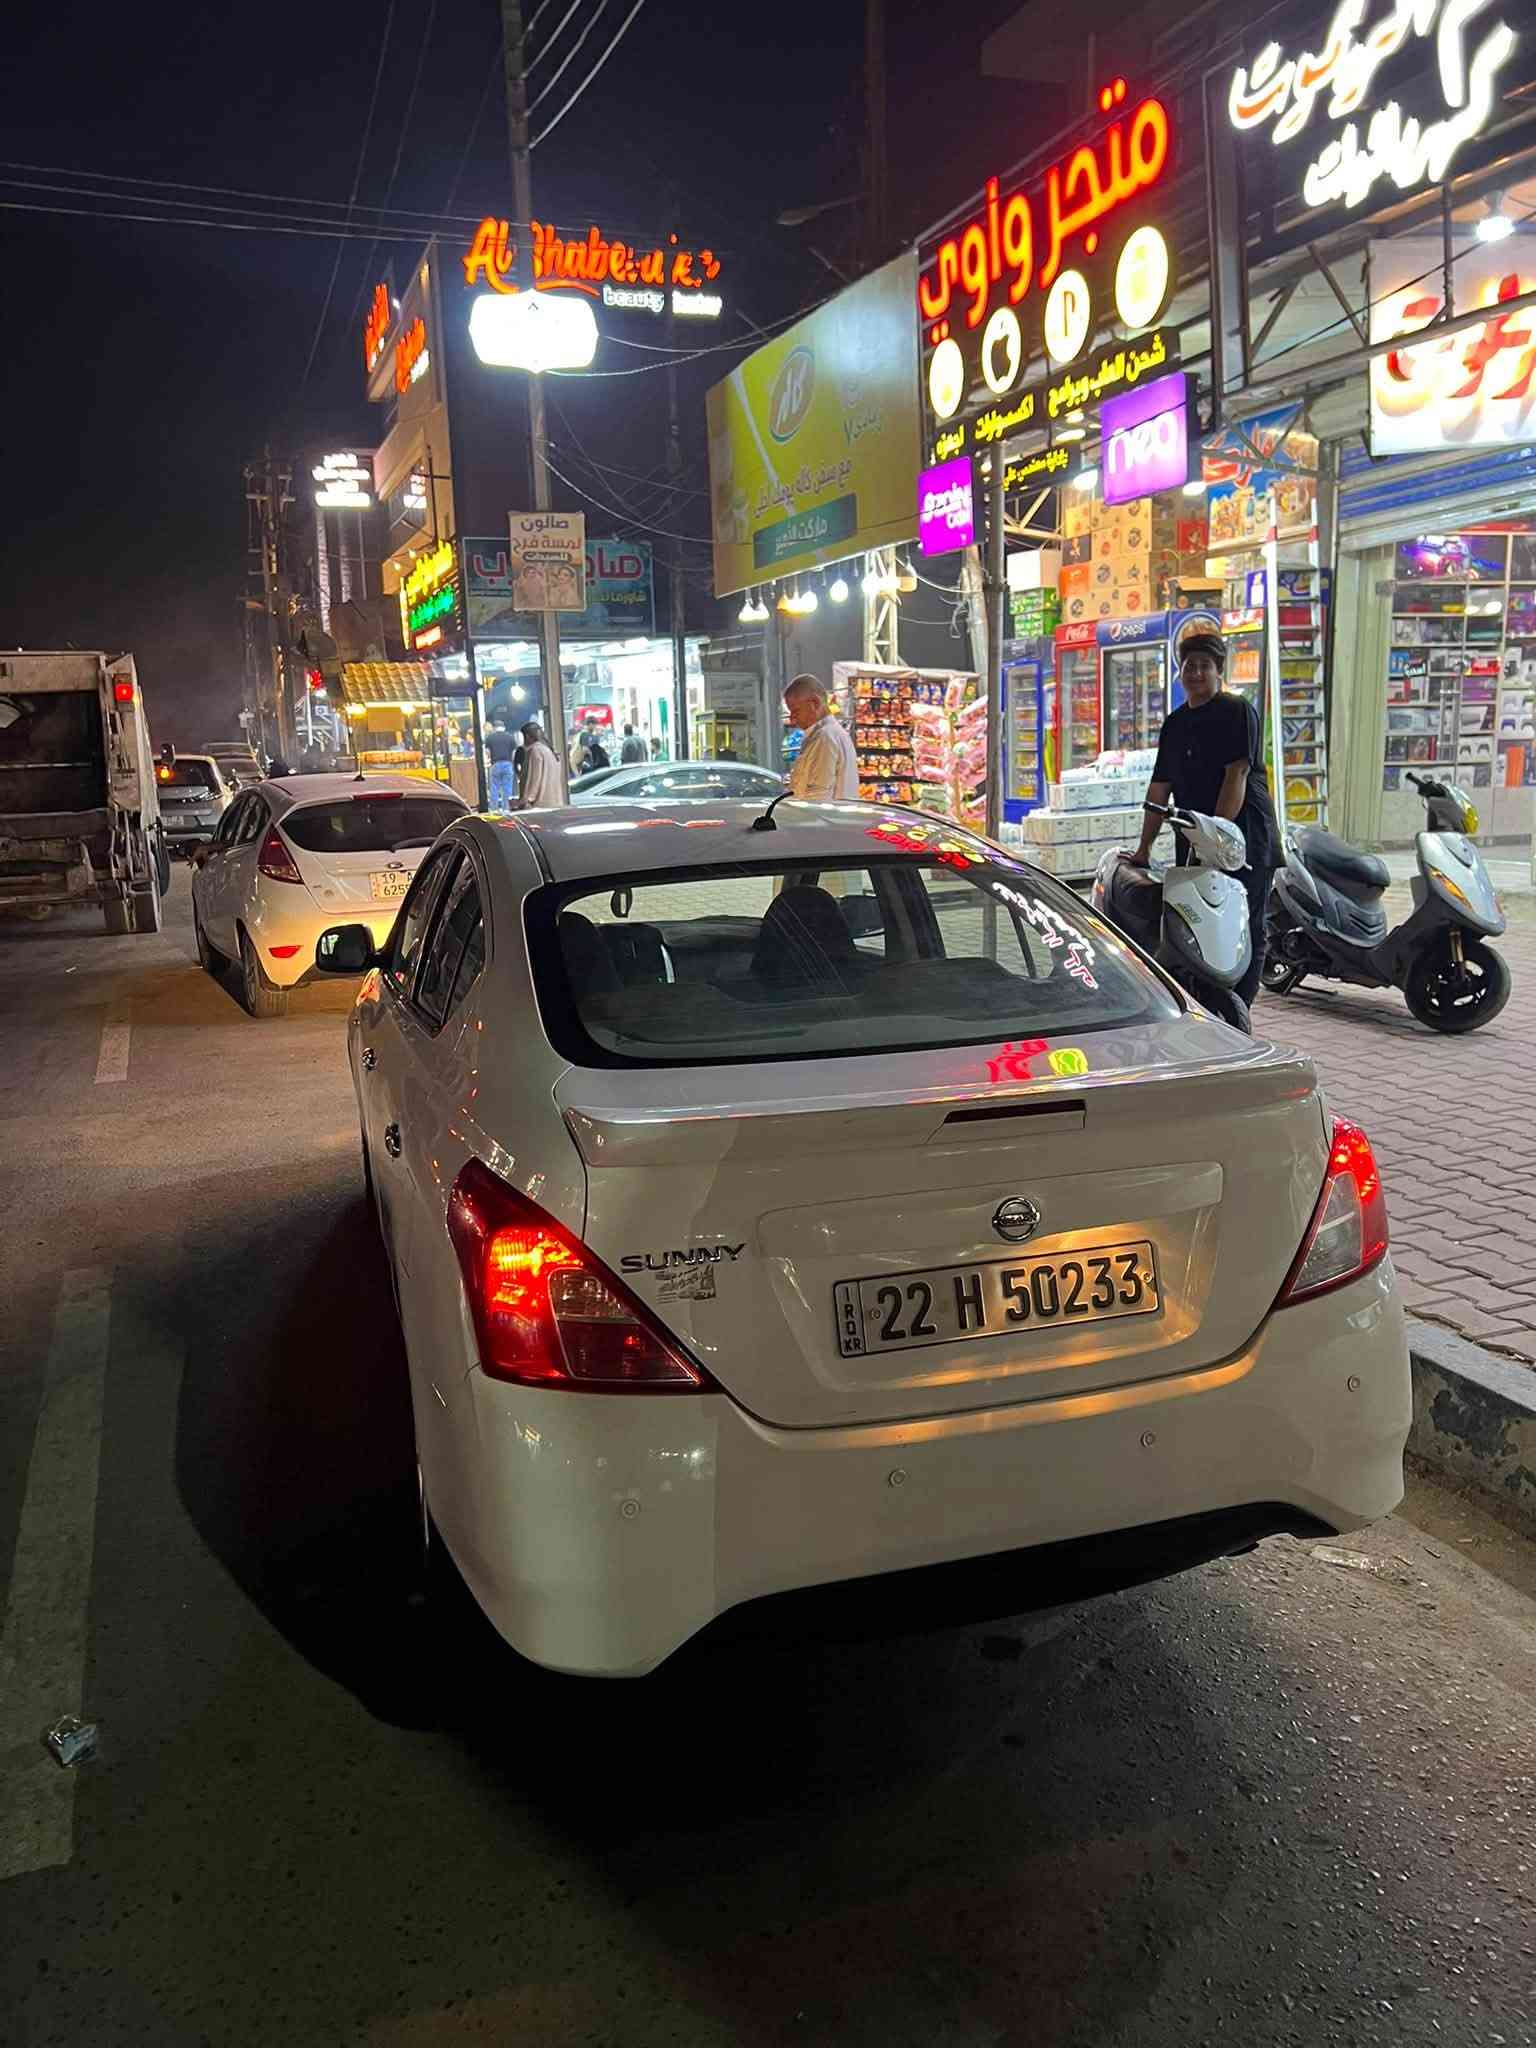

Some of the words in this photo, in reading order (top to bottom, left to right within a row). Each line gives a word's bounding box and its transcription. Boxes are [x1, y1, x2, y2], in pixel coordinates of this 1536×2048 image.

[1039, 78, 1169, 289] متجر
[520, 514, 570, 533] صالون
[512, 535, 539, 554] فرح
[542, 535, 582, 550] لمسة
[1121, 620, 1147, 638] pepsi
[620, 1242, 746, 1275] SUNNY
[877, 1285, 937, 1341] 22
[953, 1273, 986, 1330] H
[1001, 1252, 1143, 1321] 50233
